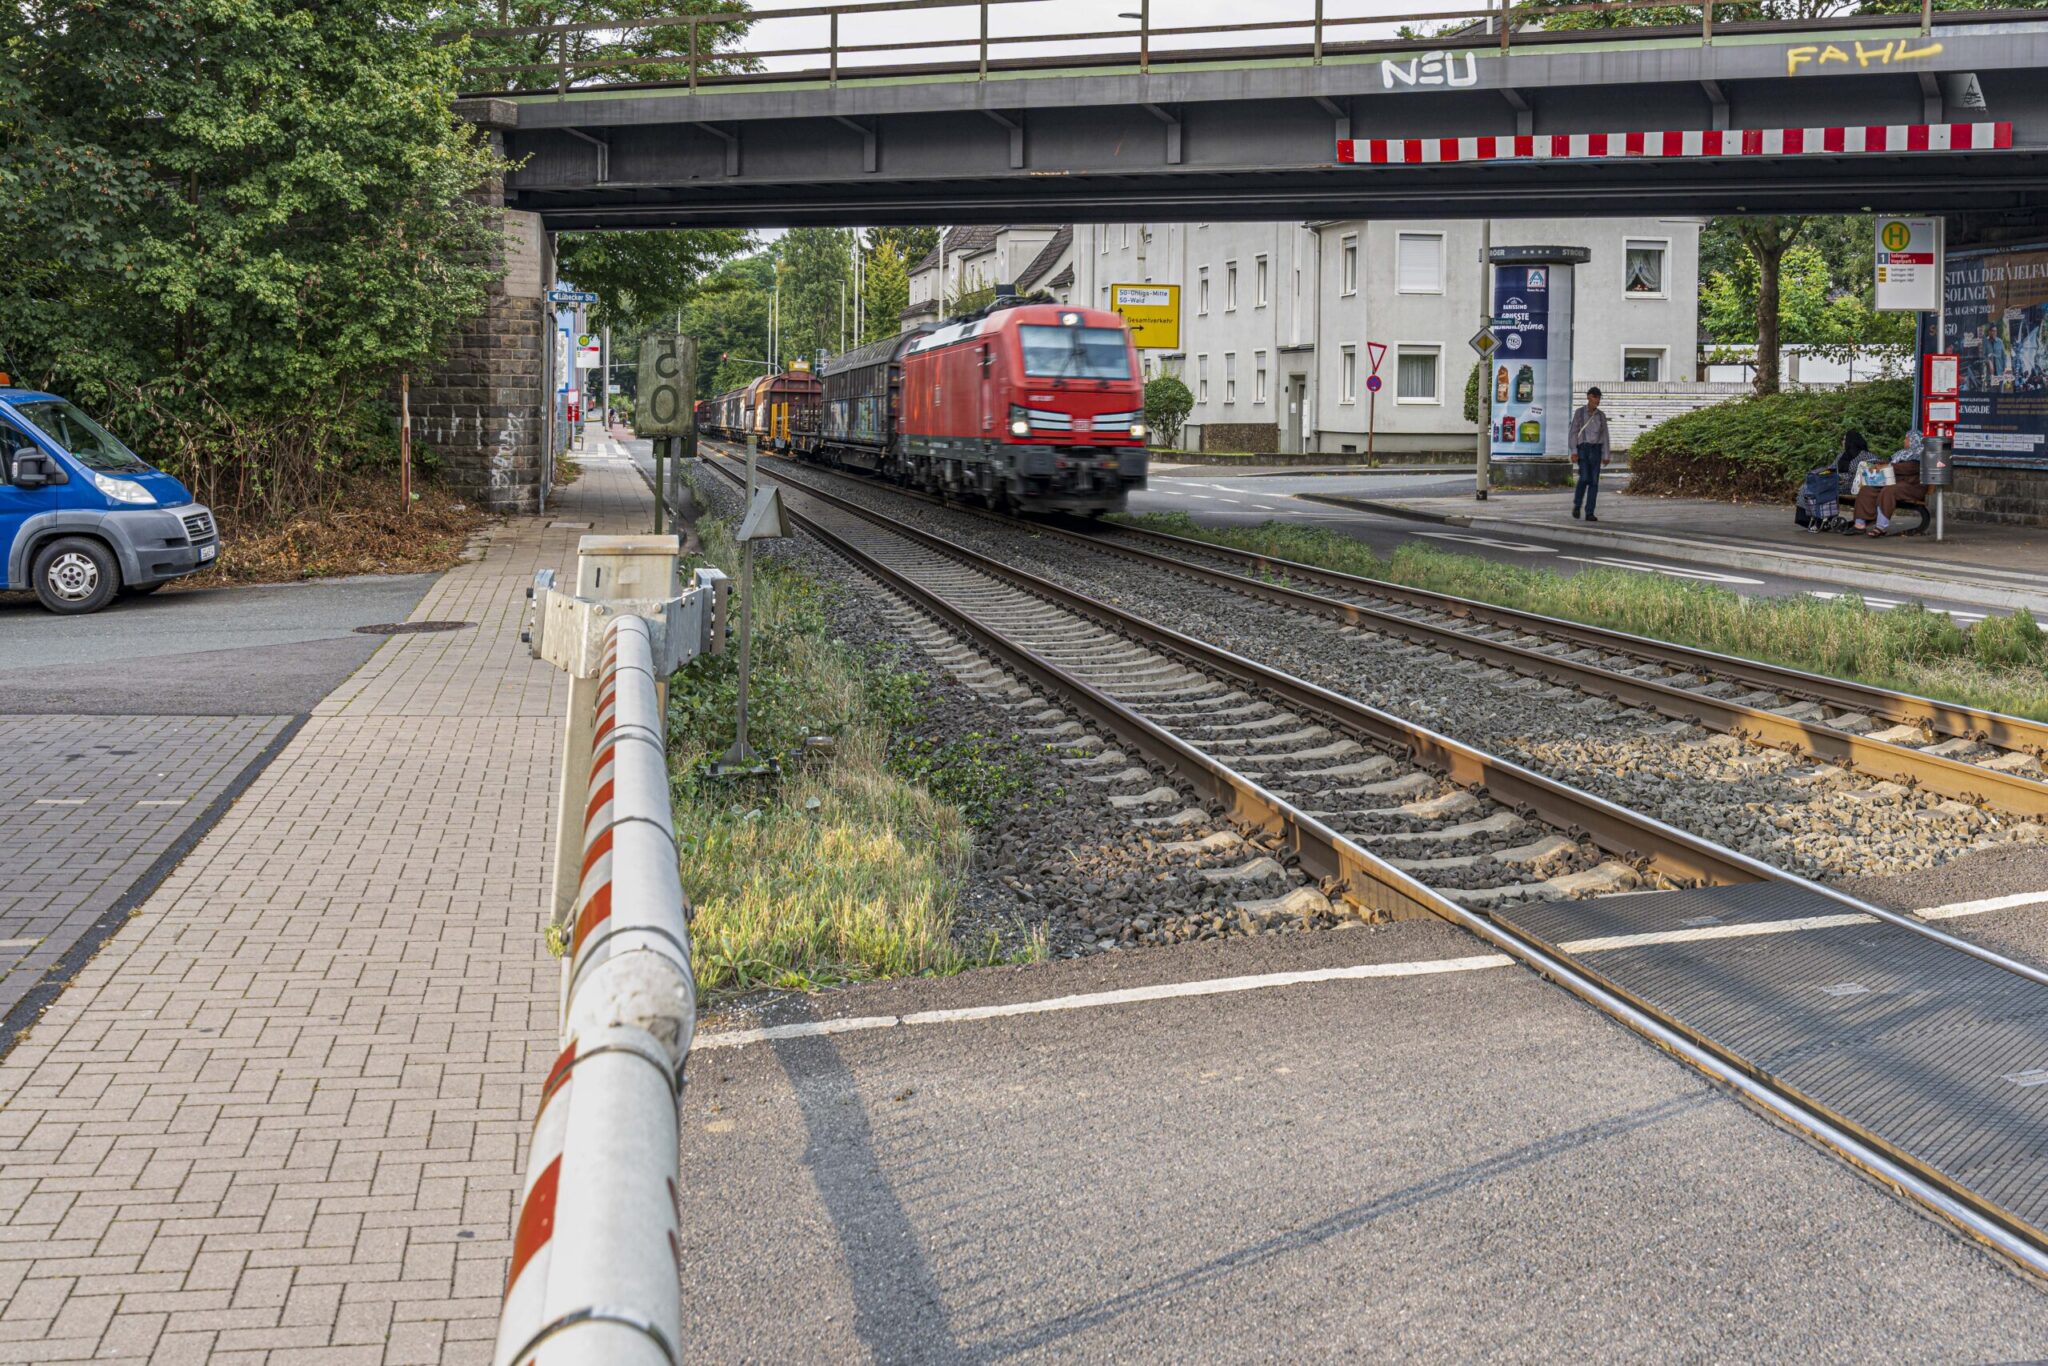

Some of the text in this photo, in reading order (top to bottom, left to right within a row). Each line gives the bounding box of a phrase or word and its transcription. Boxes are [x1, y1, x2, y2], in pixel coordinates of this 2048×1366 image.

[1787, 39, 1943, 77] FAHL
[1382, 50, 1478, 89] NEU
[1880, 254, 1886, 264] 1
[1944, 269, 1980, 285] STIVAL
[1981, 267, 2005, 282] DER
[1944, 285, 1996, 303] SOLINGEN
